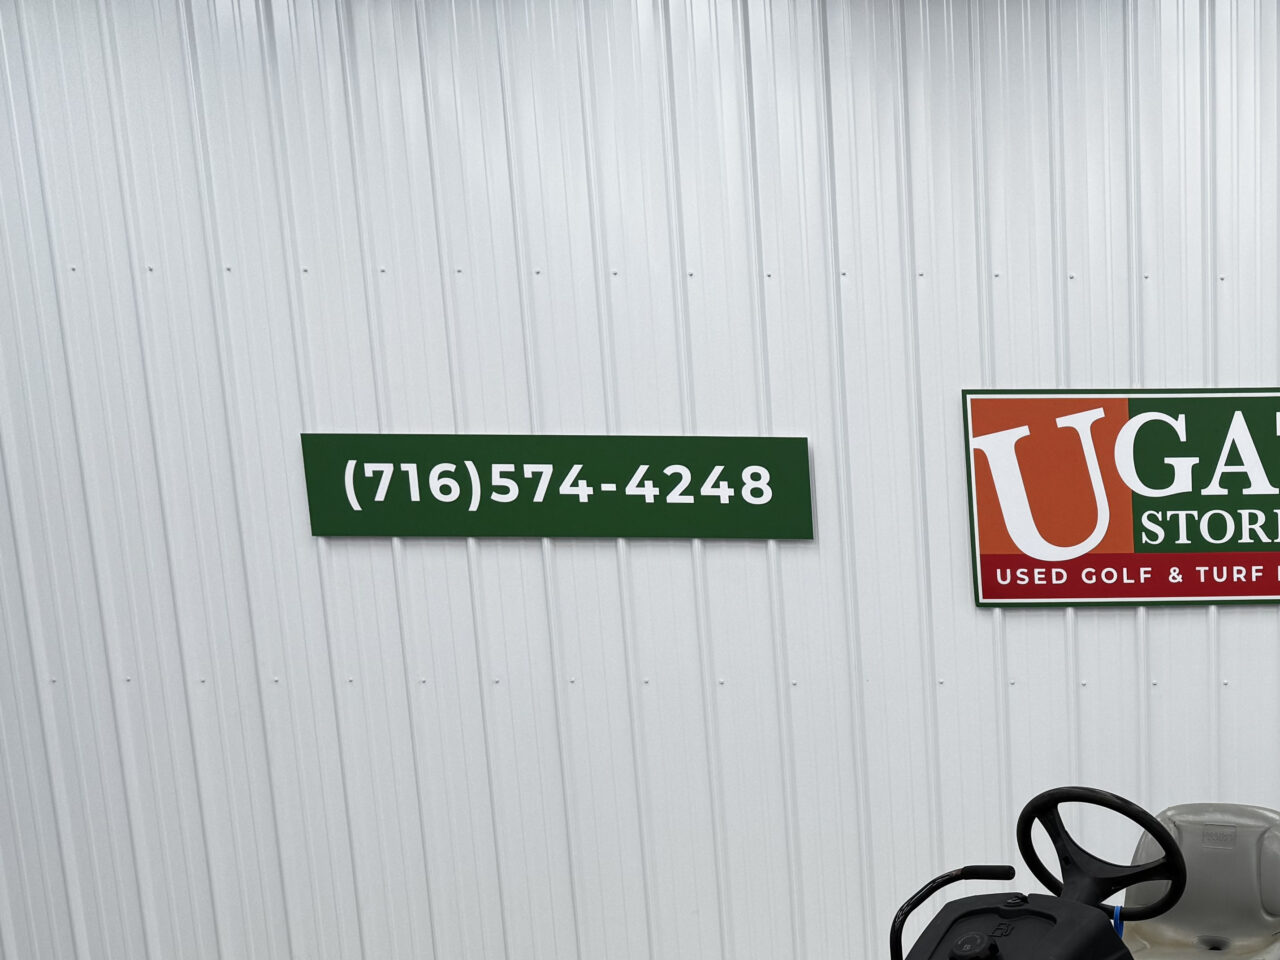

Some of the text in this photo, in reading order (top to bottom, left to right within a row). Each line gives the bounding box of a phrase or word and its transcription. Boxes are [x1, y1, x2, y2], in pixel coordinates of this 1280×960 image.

[344, 459, 773, 512] (716)574-4248
[996, 568, 1068, 585] USED
[1081, 567, 1152, 584] GOLF
[1168, 566, 1184, 584] &
[1195, 565, 1264, 583] TURF
